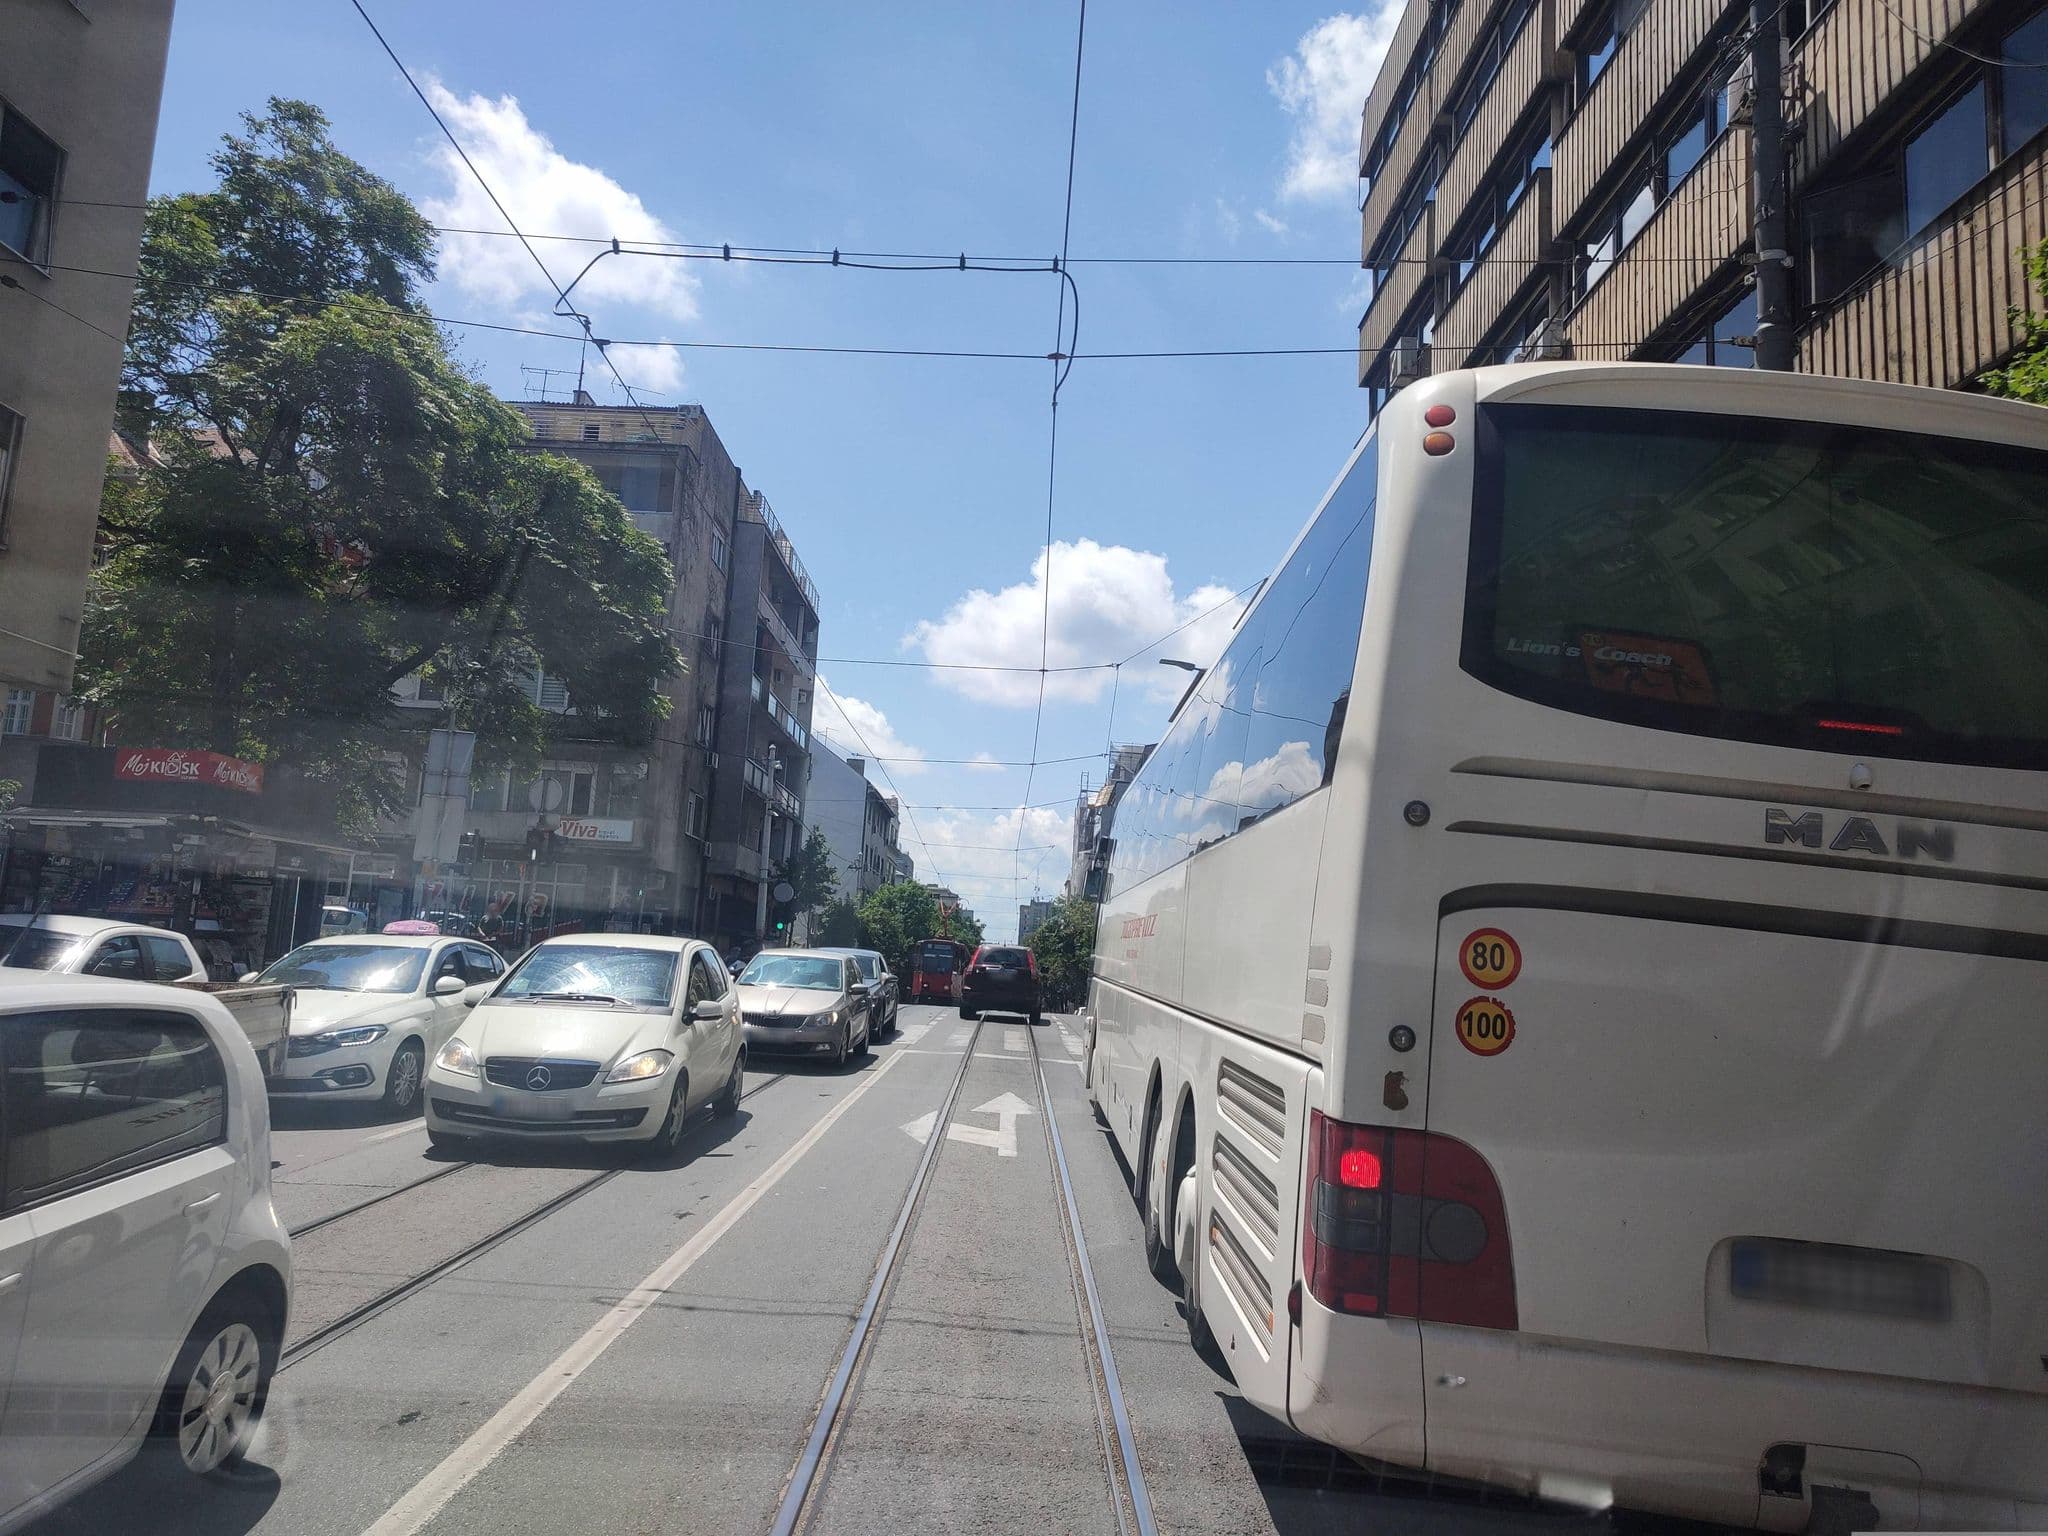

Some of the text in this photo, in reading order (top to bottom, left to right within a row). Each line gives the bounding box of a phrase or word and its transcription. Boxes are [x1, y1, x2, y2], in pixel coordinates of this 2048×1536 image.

[1506, 637, 1582, 657] Lion's
[1593, 647, 1673, 666] Coach
[561, 821, 598, 838] Viva
[1765, 808, 1955, 862] MAN
[1472, 942, 1505, 971] 80
[1463, 1011, 1506, 1040] 100
